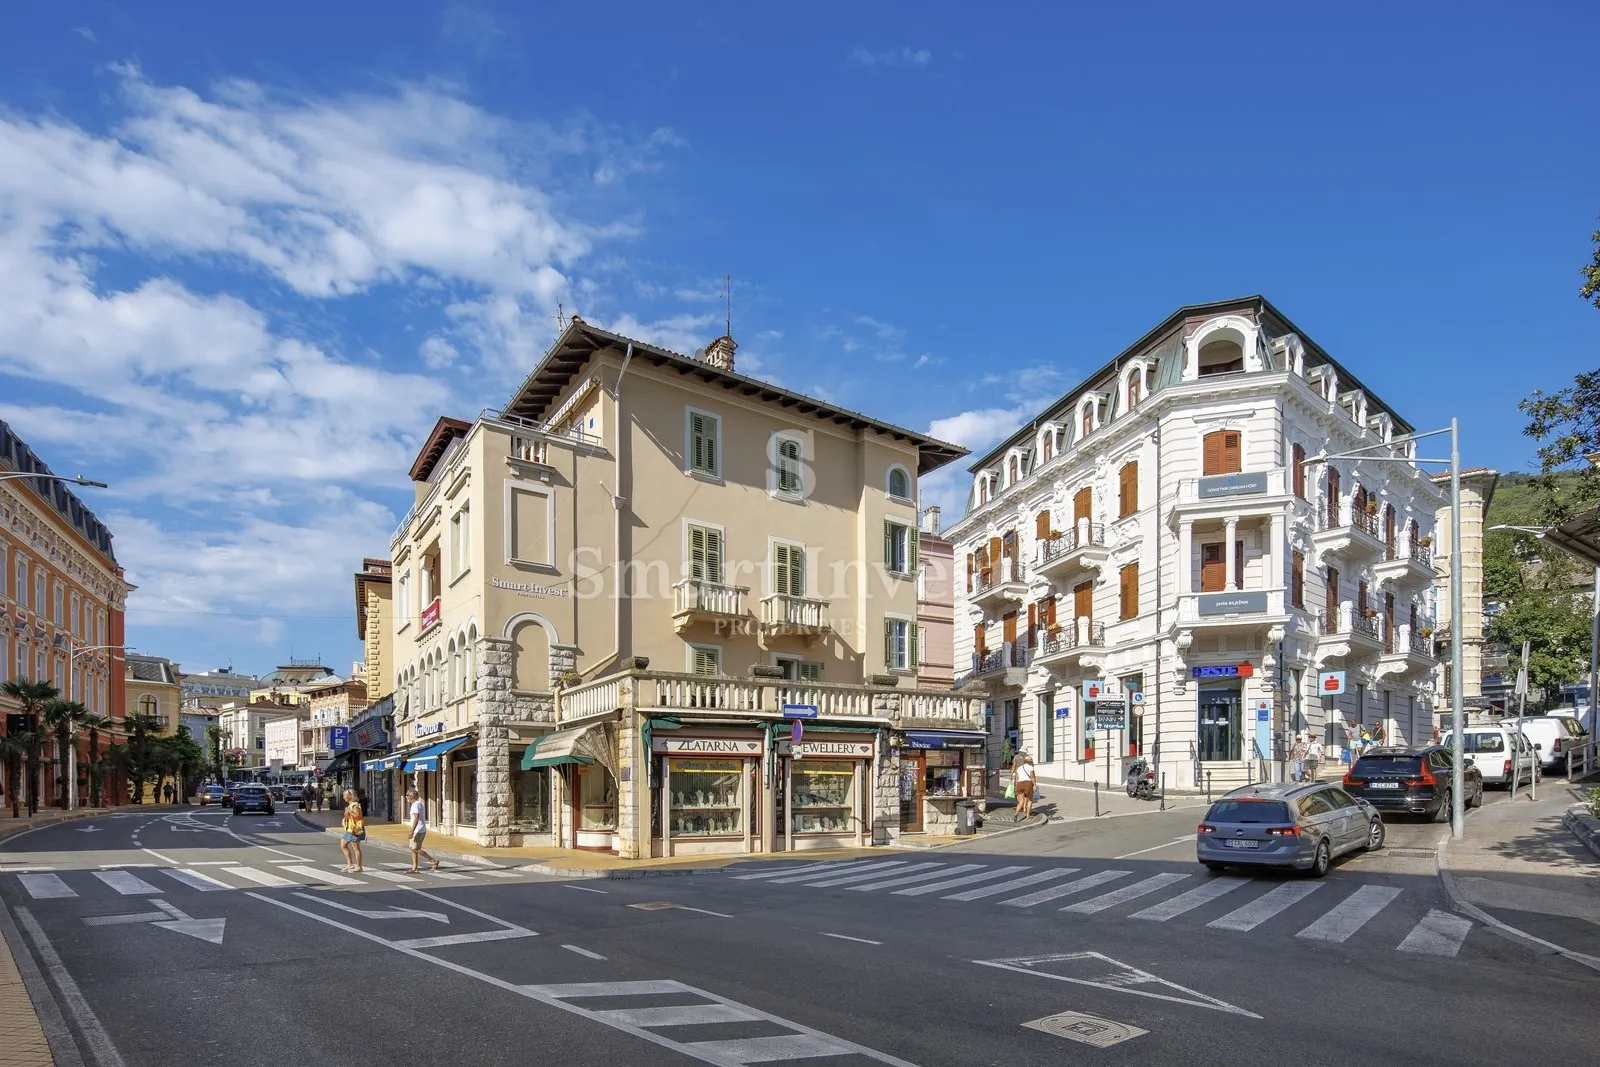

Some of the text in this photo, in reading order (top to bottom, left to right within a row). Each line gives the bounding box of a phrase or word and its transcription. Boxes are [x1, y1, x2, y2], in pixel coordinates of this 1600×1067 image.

[491, 576, 569, 598] Smart Invest
[1192, 665, 1237, 678] ERSTE
[335, 728, 343, 738] P
[678, 740, 739, 752] ZLATARNA
[801, 743, 856, 754] EWELLERY
